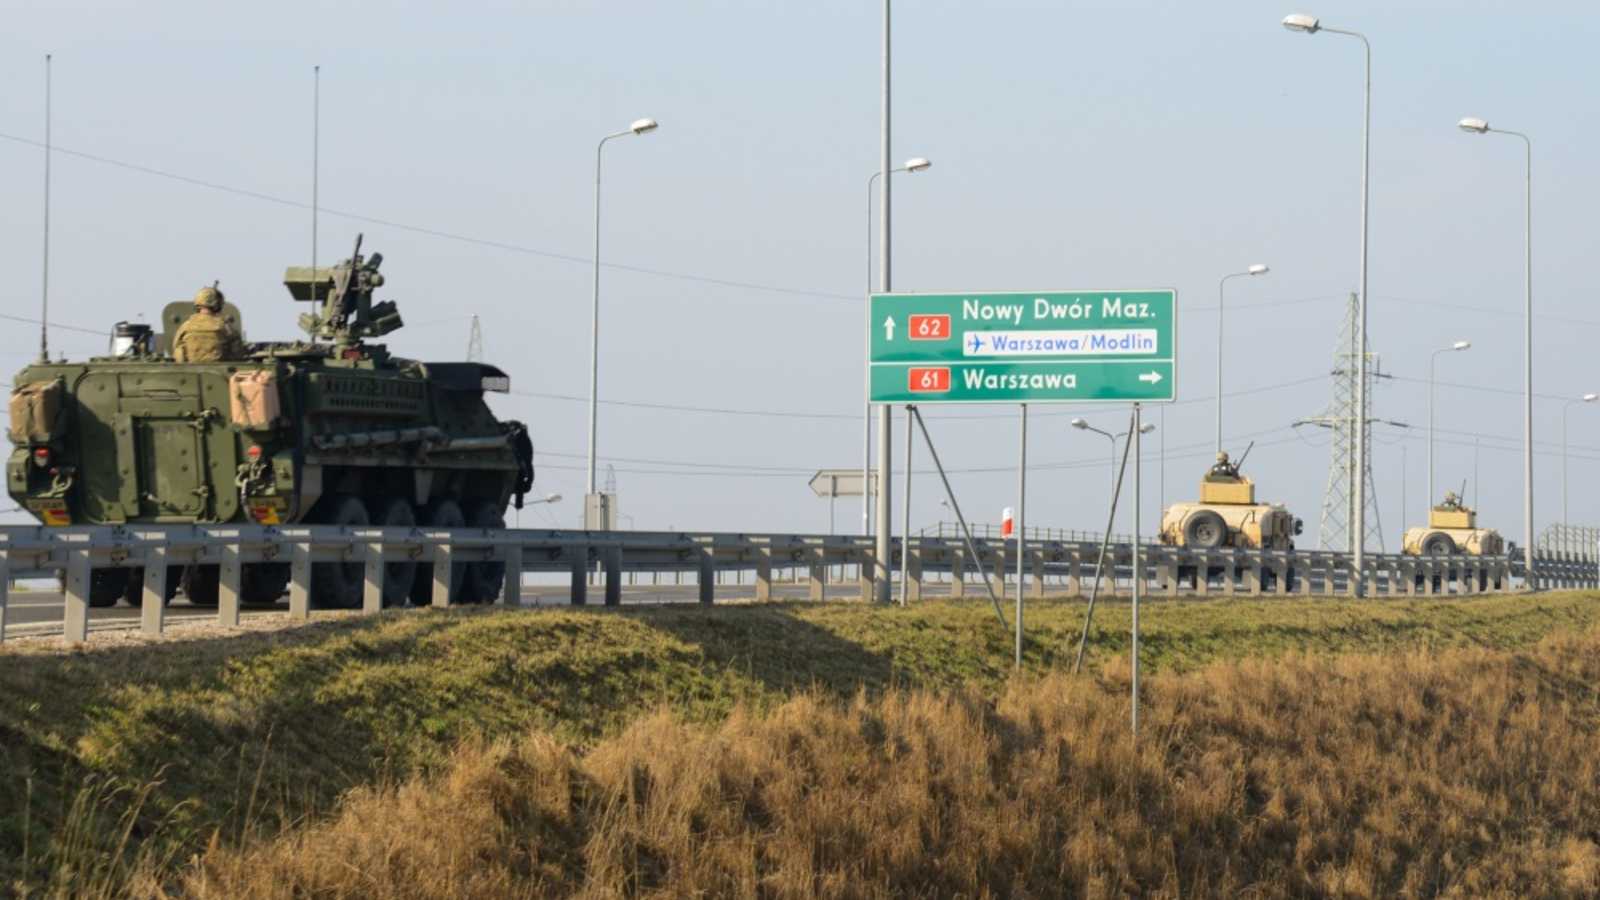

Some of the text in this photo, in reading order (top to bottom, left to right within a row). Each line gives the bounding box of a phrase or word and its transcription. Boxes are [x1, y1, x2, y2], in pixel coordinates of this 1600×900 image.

[963, 297, 1156, 325] Nowy Dwór Maz.
[918, 318, 940, 336] 62
[992, 332, 1153, 352] Warszawa/Modlin
[920, 370, 939, 388] 61
[963, 368, 1076, 389] Warszawa
